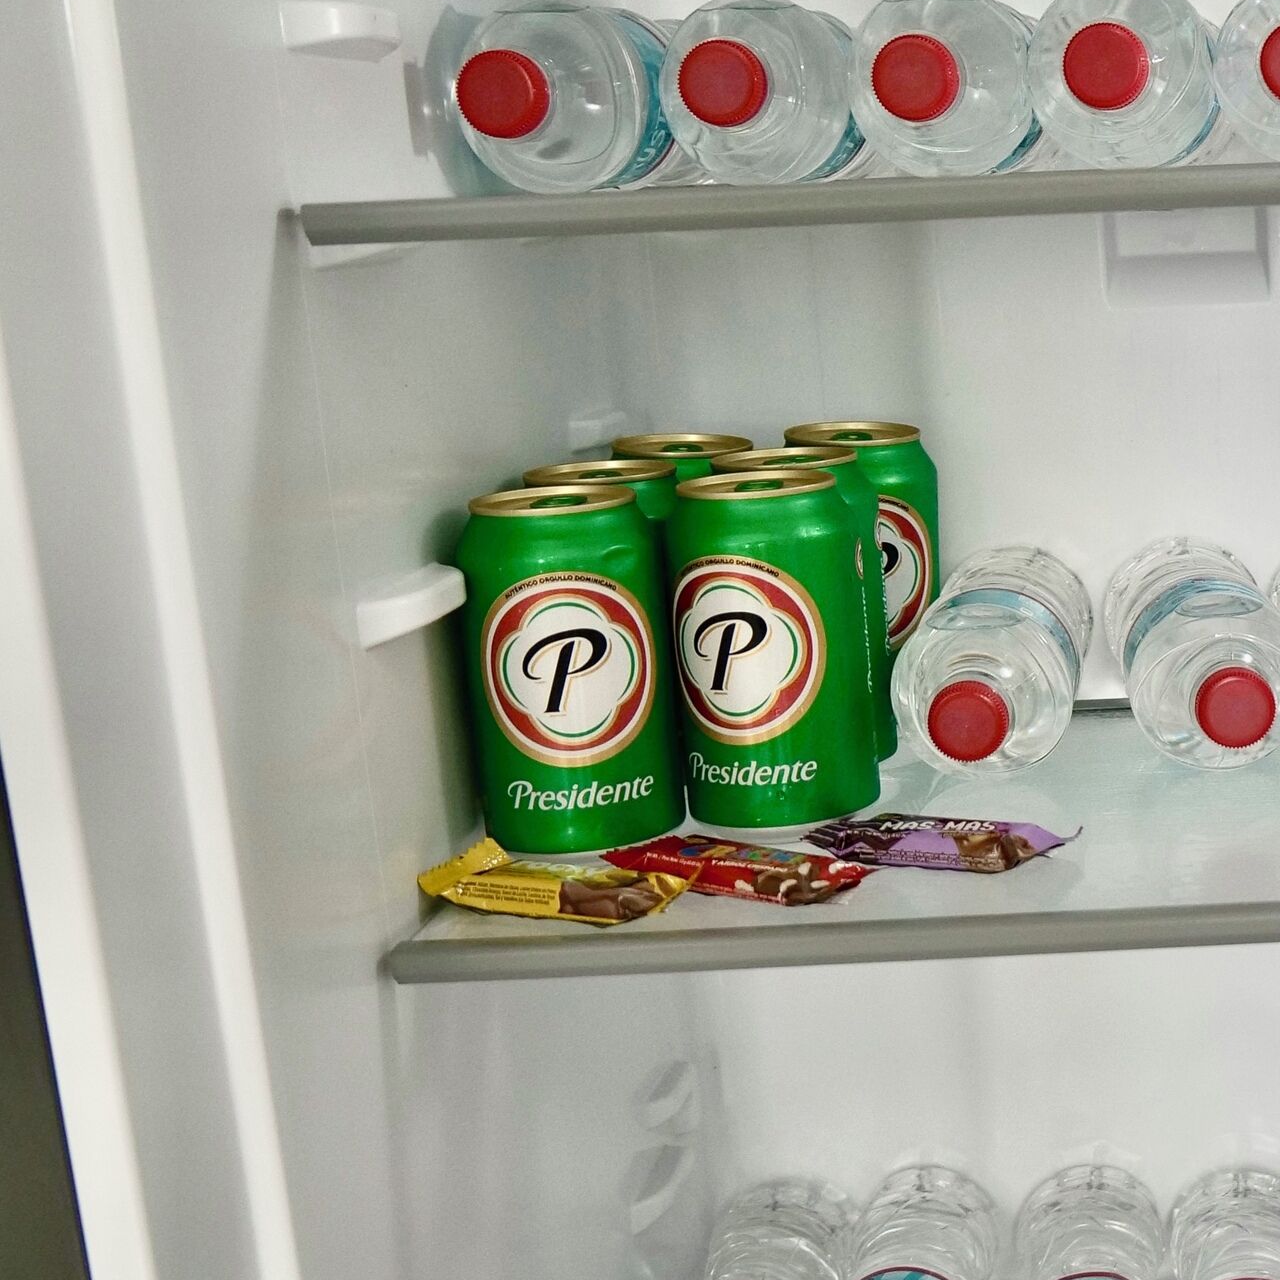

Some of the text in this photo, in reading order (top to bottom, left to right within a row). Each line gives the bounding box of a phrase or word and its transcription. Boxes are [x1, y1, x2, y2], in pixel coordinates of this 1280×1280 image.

[538, 574, 573, 585] ORGULLO
[574, 574, 617, 592] DOMINICANO
[735, 559, 780, 578] DOMINICANO
[693, 611, 768, 691] P
[522, 627, 608, 714] P
[688, 751, 818, 787] Presidente
[507, 774, 655, 811] Presidente
[878, 820, 998, 832] MAS-MAS
